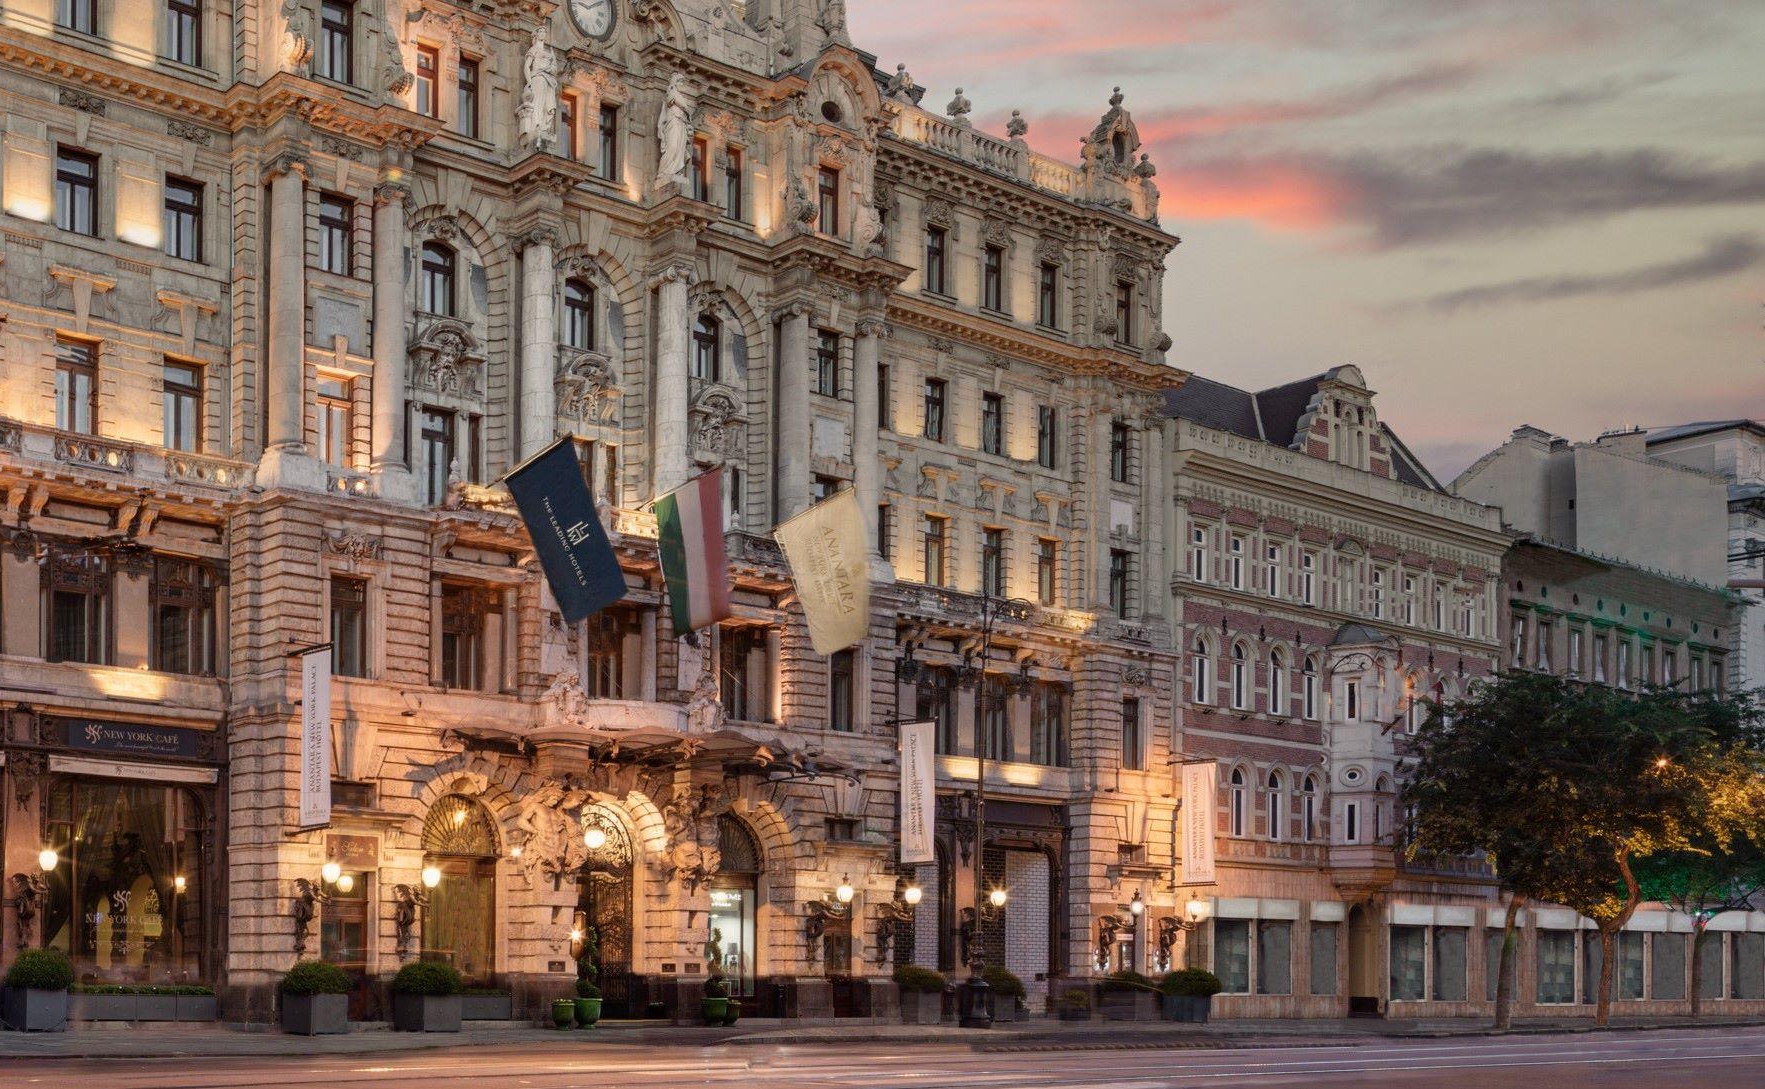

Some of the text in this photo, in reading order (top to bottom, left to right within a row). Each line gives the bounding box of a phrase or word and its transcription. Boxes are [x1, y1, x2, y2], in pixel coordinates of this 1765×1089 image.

[542, 496, 587, 586] THE LEADING HOTELS
[821, 526, 856, 614] ANANTARA
[104, 730, 179, 744] NEW YORK CAFÉ
